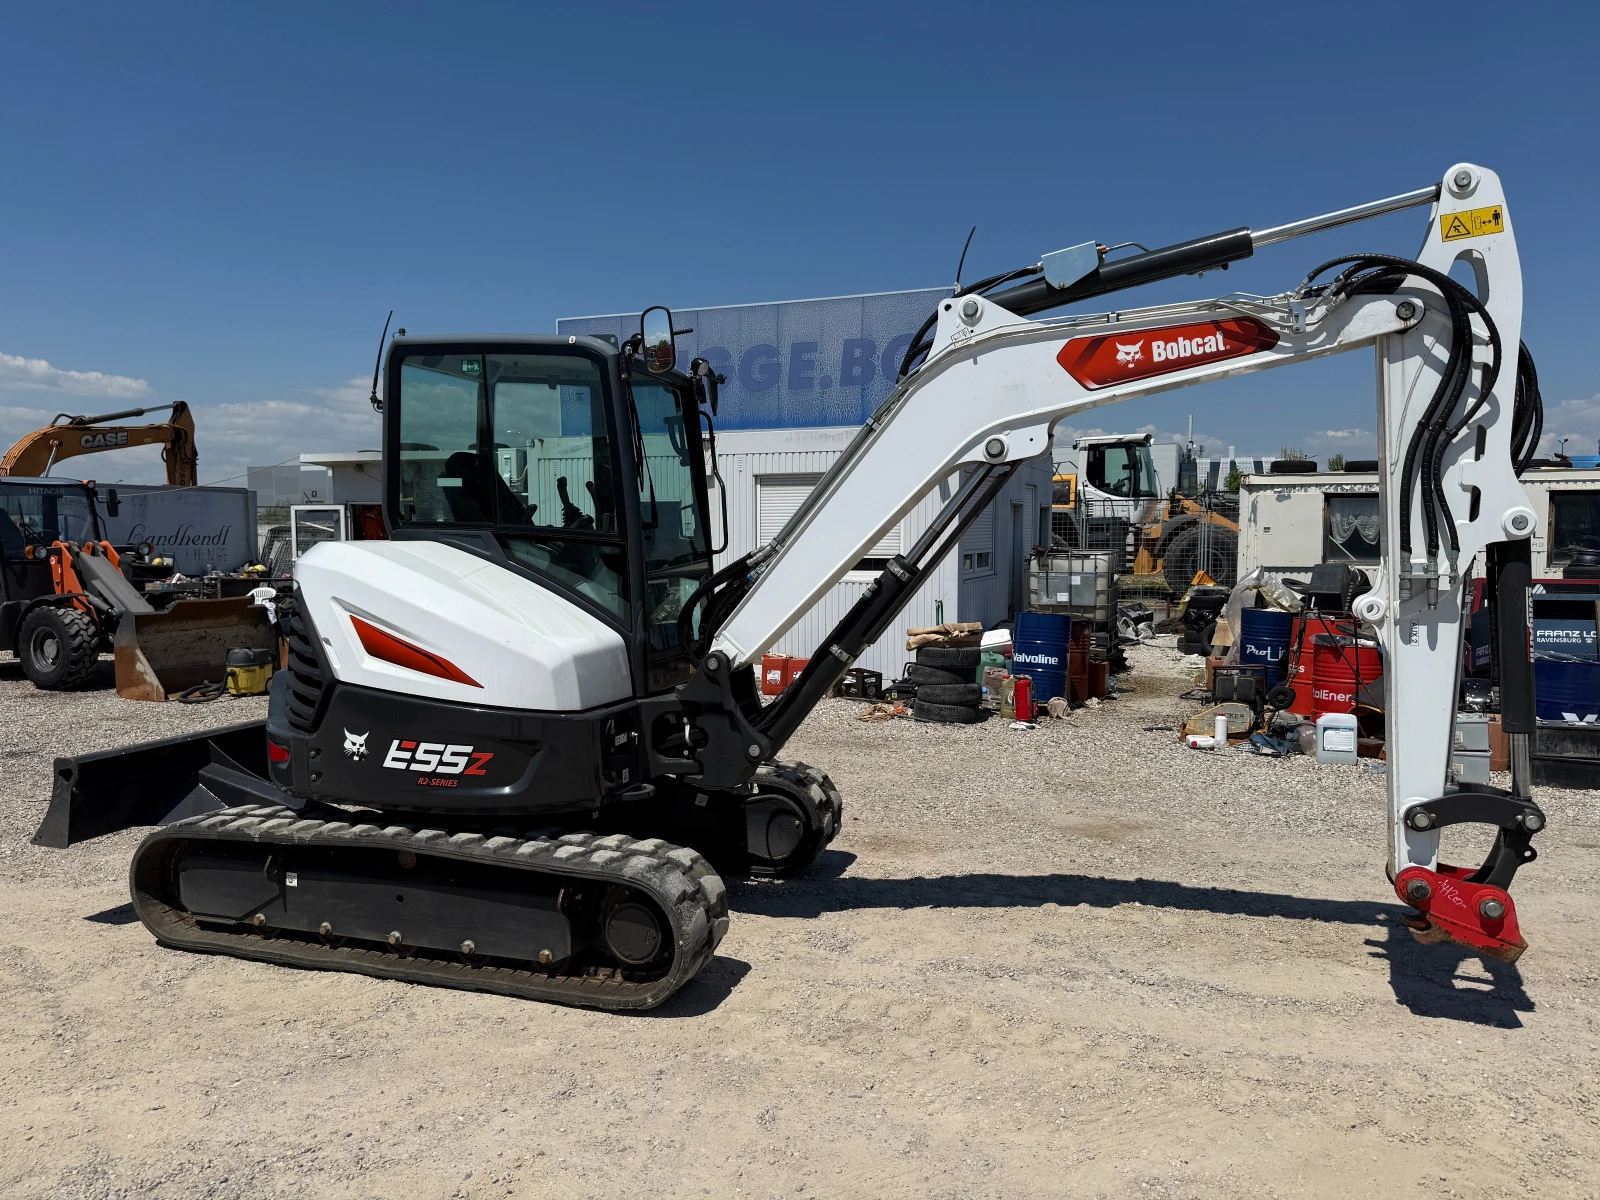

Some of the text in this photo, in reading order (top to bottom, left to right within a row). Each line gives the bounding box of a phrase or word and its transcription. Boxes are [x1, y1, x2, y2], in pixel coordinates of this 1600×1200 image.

[1152, 331, 1225, 362] Bobcat
[80, 432, 129, 448] CASE
[28, 487, 65, 495] HITACHI
[126, 524, 232, 546] Landhendl
[1410, 621, 1418, 637] AUX
[1536, 630, 1580, 638] FRANZ
[1212, 711, 1245, 720] WCKER
[417, 777, 459, 787] R2-SERIES
